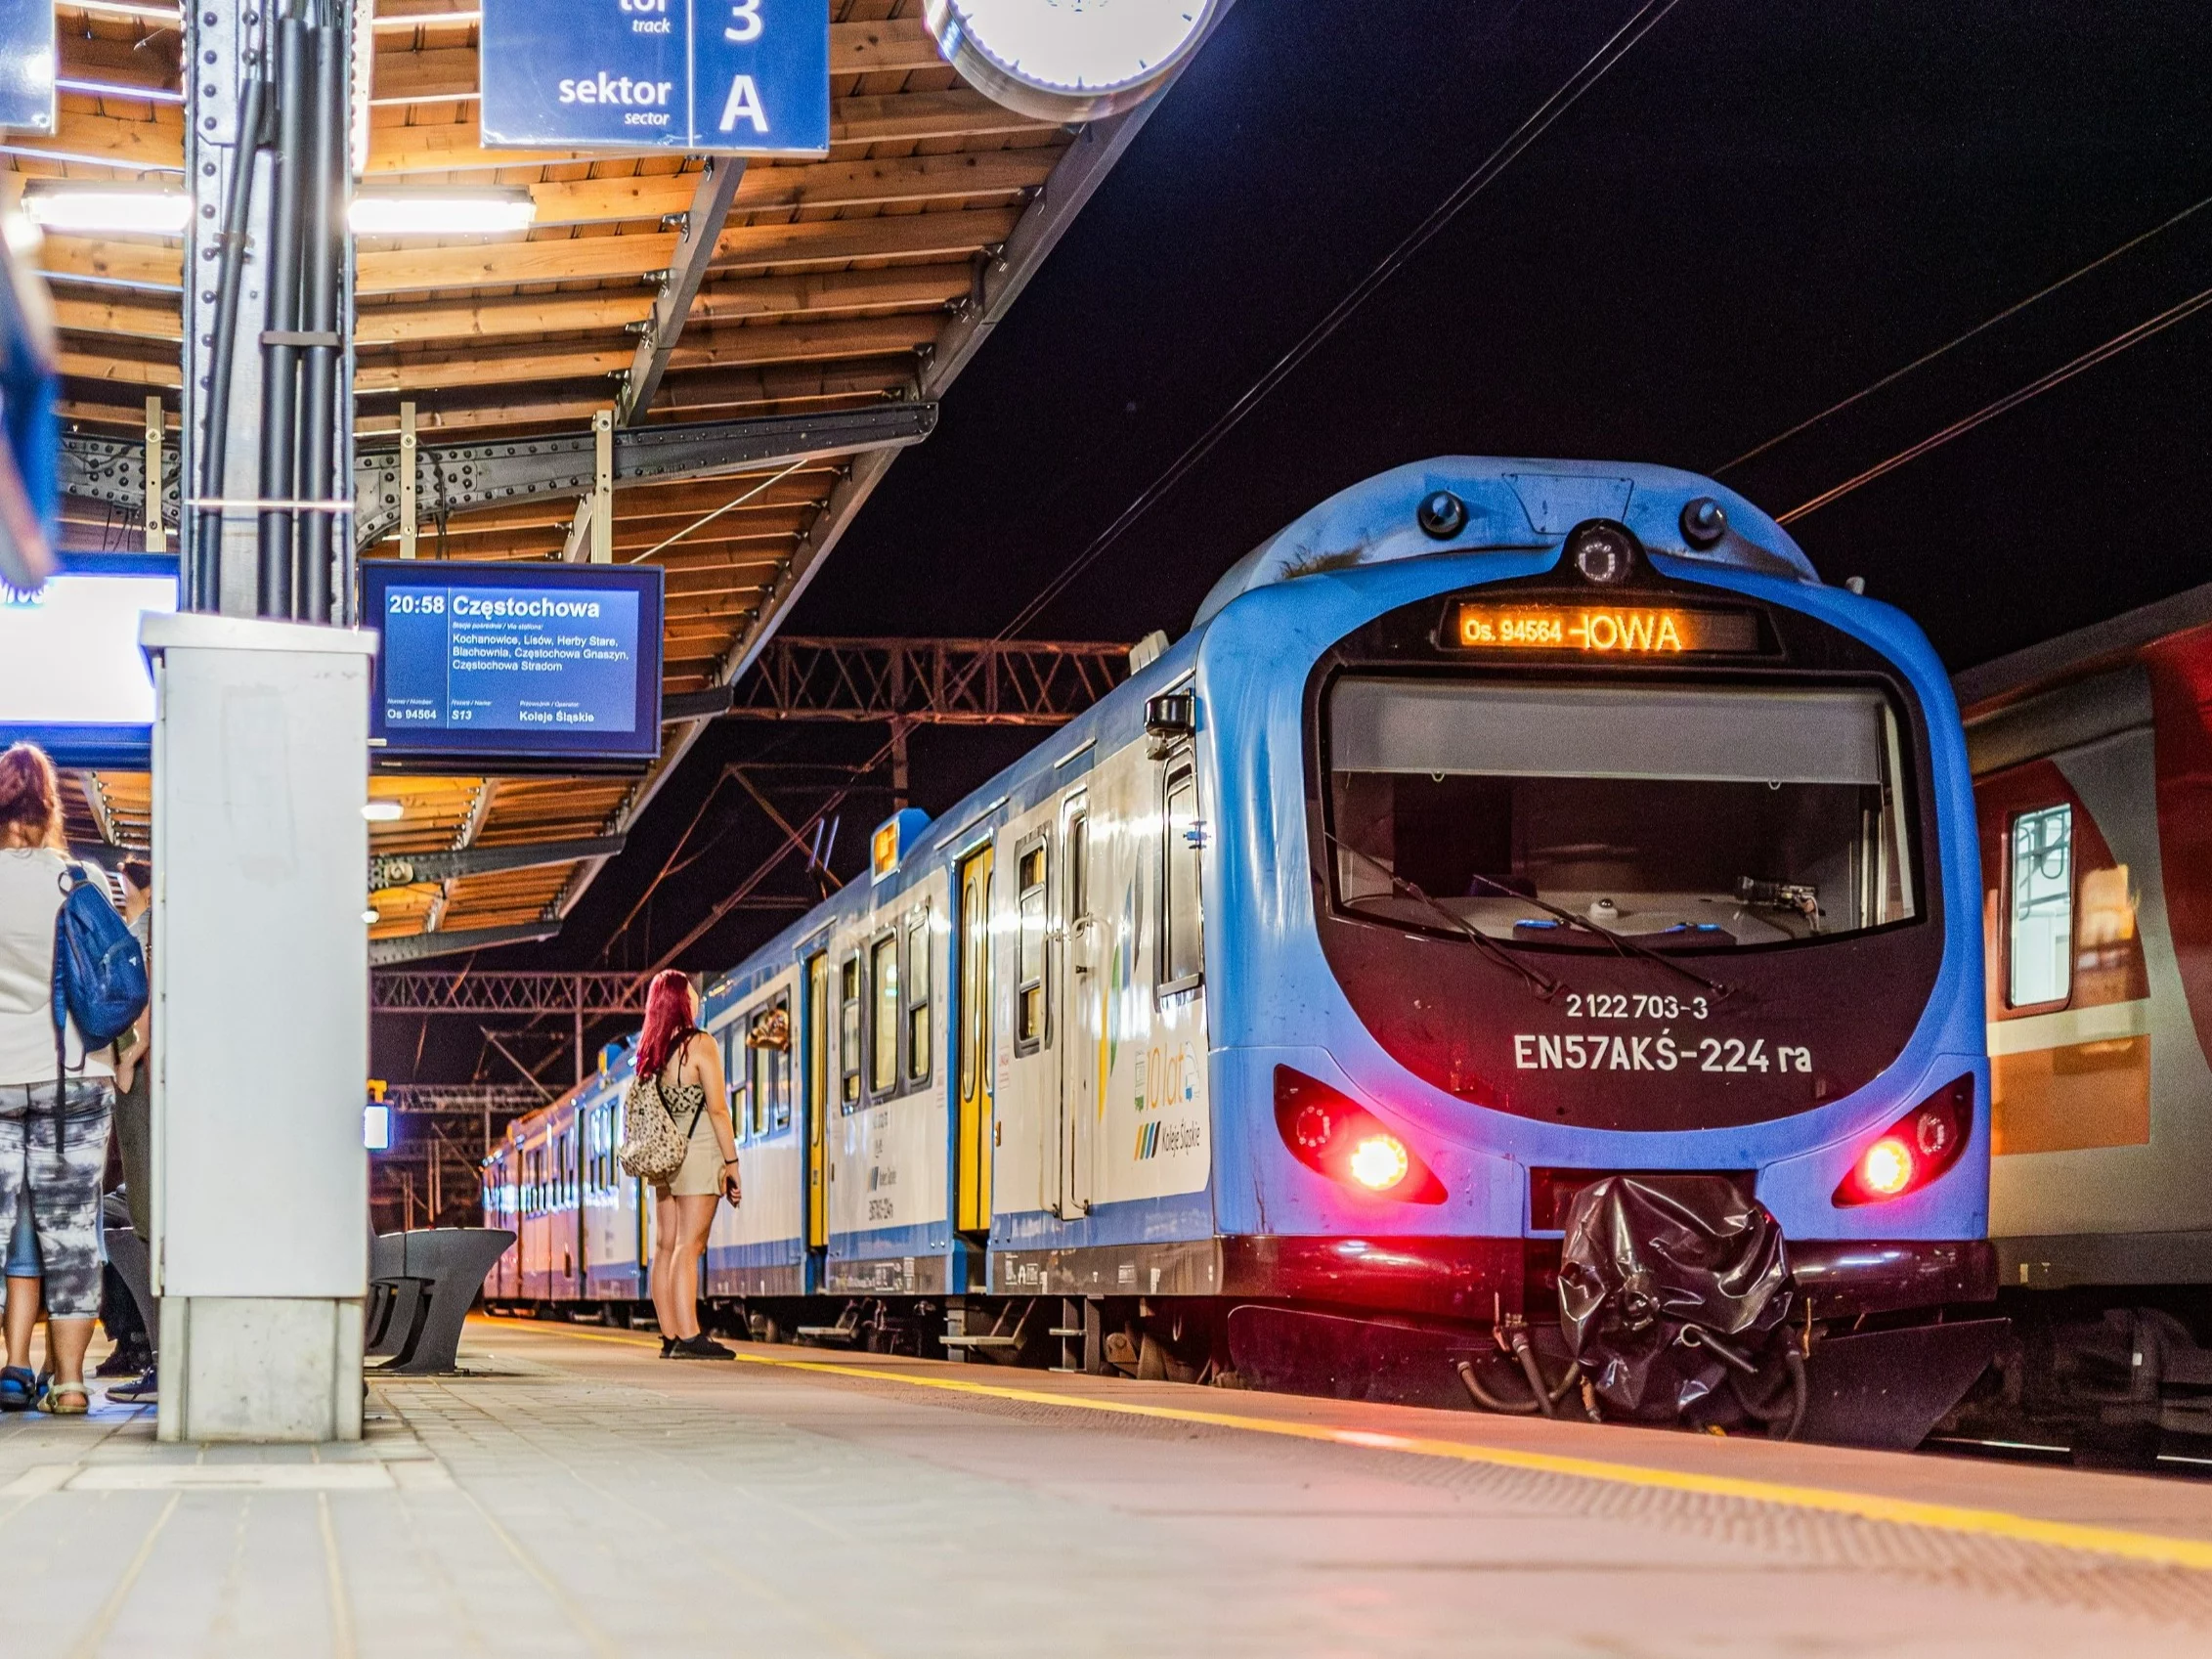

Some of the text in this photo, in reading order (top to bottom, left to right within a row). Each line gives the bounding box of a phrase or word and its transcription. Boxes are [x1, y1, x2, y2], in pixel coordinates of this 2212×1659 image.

[632, 18, 671, 34] track
[724, 0, 762, 41] 3
[558, 71, 672, 106] sektor
[719, 75, 768, 133] A
[624, 112, 670, 126] sector
[389, 595, 445, 614] 20:58
[453, 595, 600, 620] Częstochowa
[453, 633, 619, 648] Kochanowice, Lisów, Herby Stare,
[1499, 620, 1562, 642] 94564
[453, 647, 629, 661] Blachownia, Częstochowa Gnaszyn,
[453, 660, 563, 672] Częstochowa Stradom
[387, 709, 437, 720] Os 94564
[452, 710, 472, 720] S13
[519, 710, 595, 724] Koleje Śląskie
[1514, 1028, 1812, 1073] EN57AKŚ-224 ra
[1162, 1042, 1184, 1107] lat
[1161, 1123, 1180, 1157] Koleje
